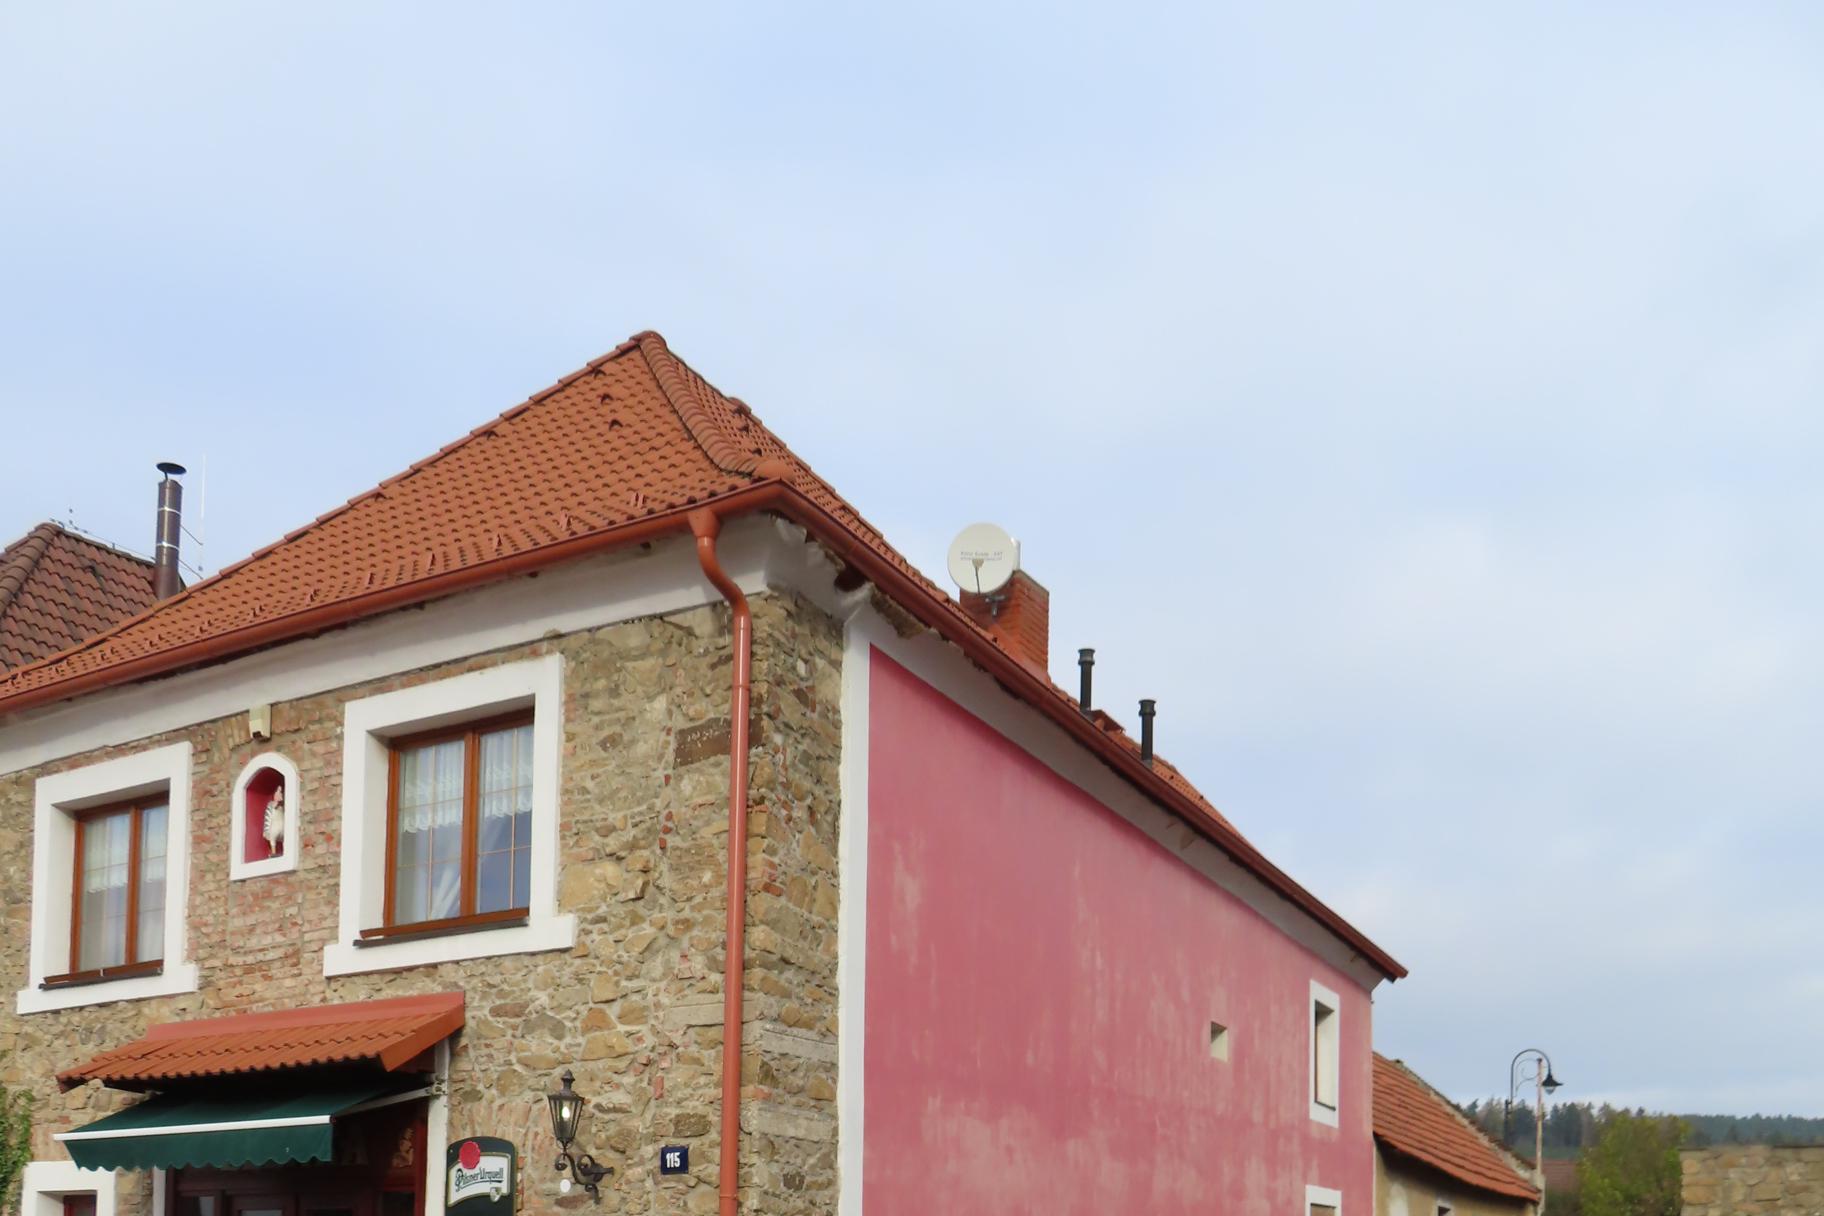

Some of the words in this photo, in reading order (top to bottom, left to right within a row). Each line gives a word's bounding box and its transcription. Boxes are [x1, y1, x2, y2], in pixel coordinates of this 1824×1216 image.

[665, 1152, 681, 1168] 115
[455, 1167, 479, 1192] Pilsner
[479, 1166, 504, 1184] Urquell
